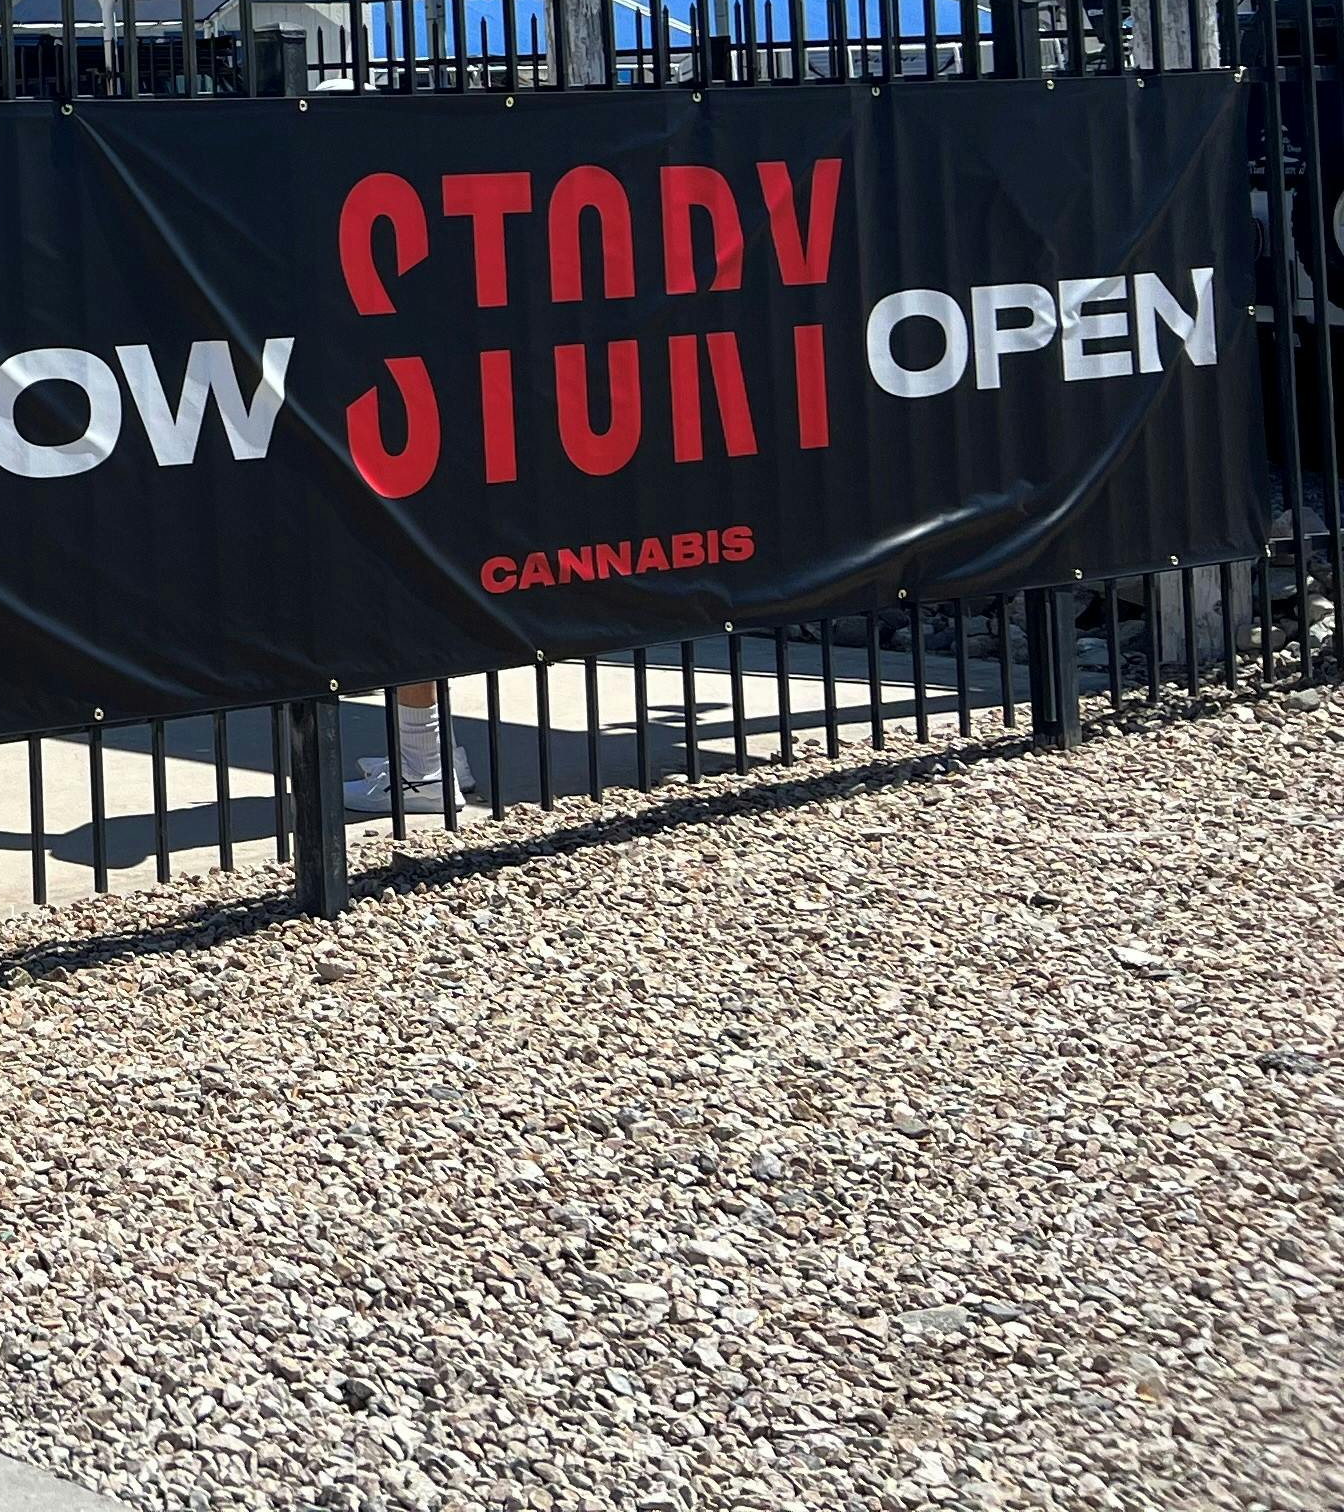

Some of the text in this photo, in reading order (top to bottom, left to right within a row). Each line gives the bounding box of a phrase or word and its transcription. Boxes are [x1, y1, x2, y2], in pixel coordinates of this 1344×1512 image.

[338, 158, 843, 499] STORY
[865, 267, 1218, 399] OPEN
[480, 525, 755, 594] CANNABIS
